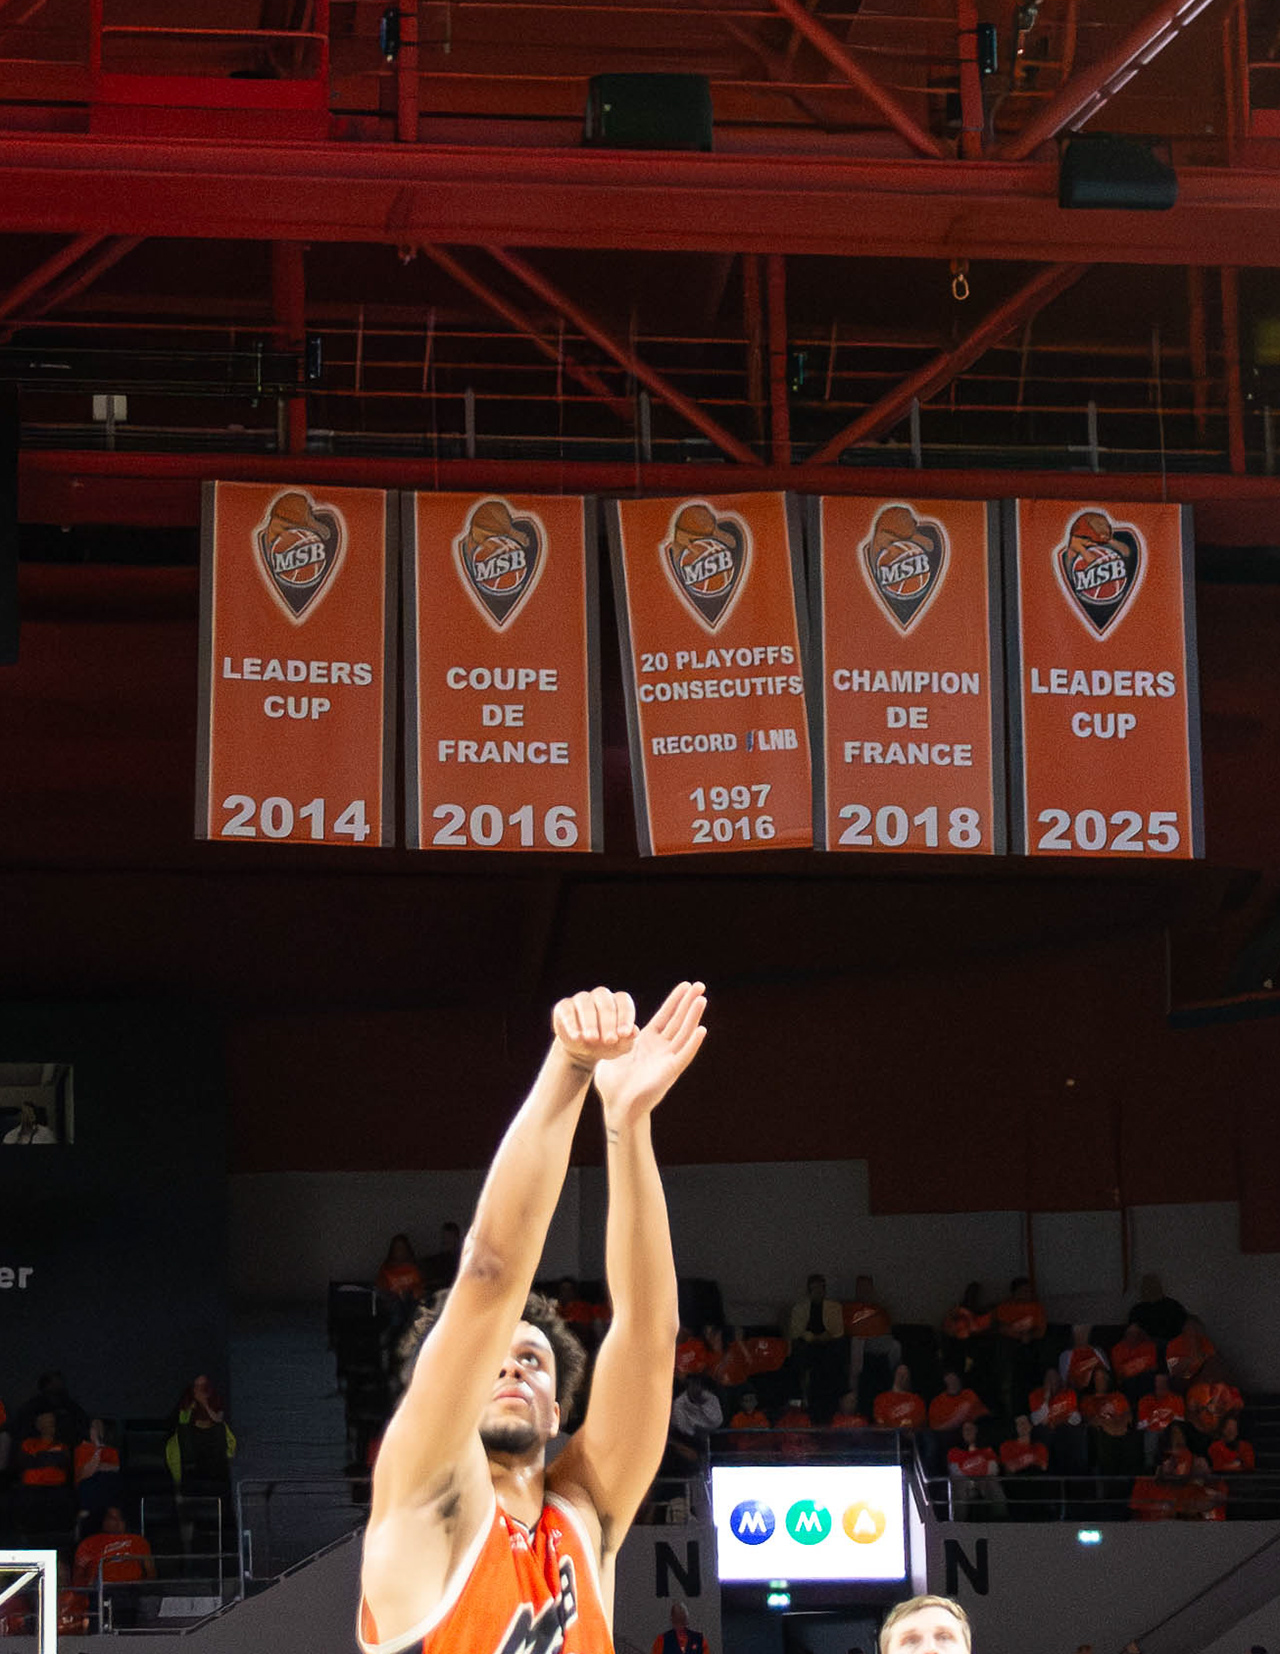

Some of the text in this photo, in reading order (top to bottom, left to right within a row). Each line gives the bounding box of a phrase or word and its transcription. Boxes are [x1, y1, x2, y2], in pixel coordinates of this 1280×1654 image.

[274, 541, 327, 573] MSB
[475, 550, 527, 583] MSB
[682, 550, 733, 585] MSB
[879, 551, 931, 587] MSB
[1074, 557, 1127, 592] MSB
[223, 657, 373, 686] LEADERS
[641, 645, 795, 672] 20 PLAYOFFS
[446, 667, 558, 692] COUPE
[639, 676, 804, 703] CONSECUTIFS
[832, 668, 980, 695] CHAMPION
[1030, 668, 1176, 698] LEADERS
[263, 696, 331, 721] CUP
[482, 704, 524, 727] DE
[886, 706, 928, 730] DE
[1071, 712, 1137, 739] CUP
[438, 739, 569, 764] FRANCE
[652, 728, 799, 756] RECORD LNB
[843, 741, 973, 767] FRANCE
[689, 783, 772, 812] 1997
[221, 794, 370, 842] 2014
[432, 804, 578, 848] 2016
[690, 815, 776, 844] 2016
[838, 803, 982, 848] 2018
[1037, 808, 1180, 852] 2025
[655, 1541, 701, 1597] N
[944, 1538, 990, 1596] N
